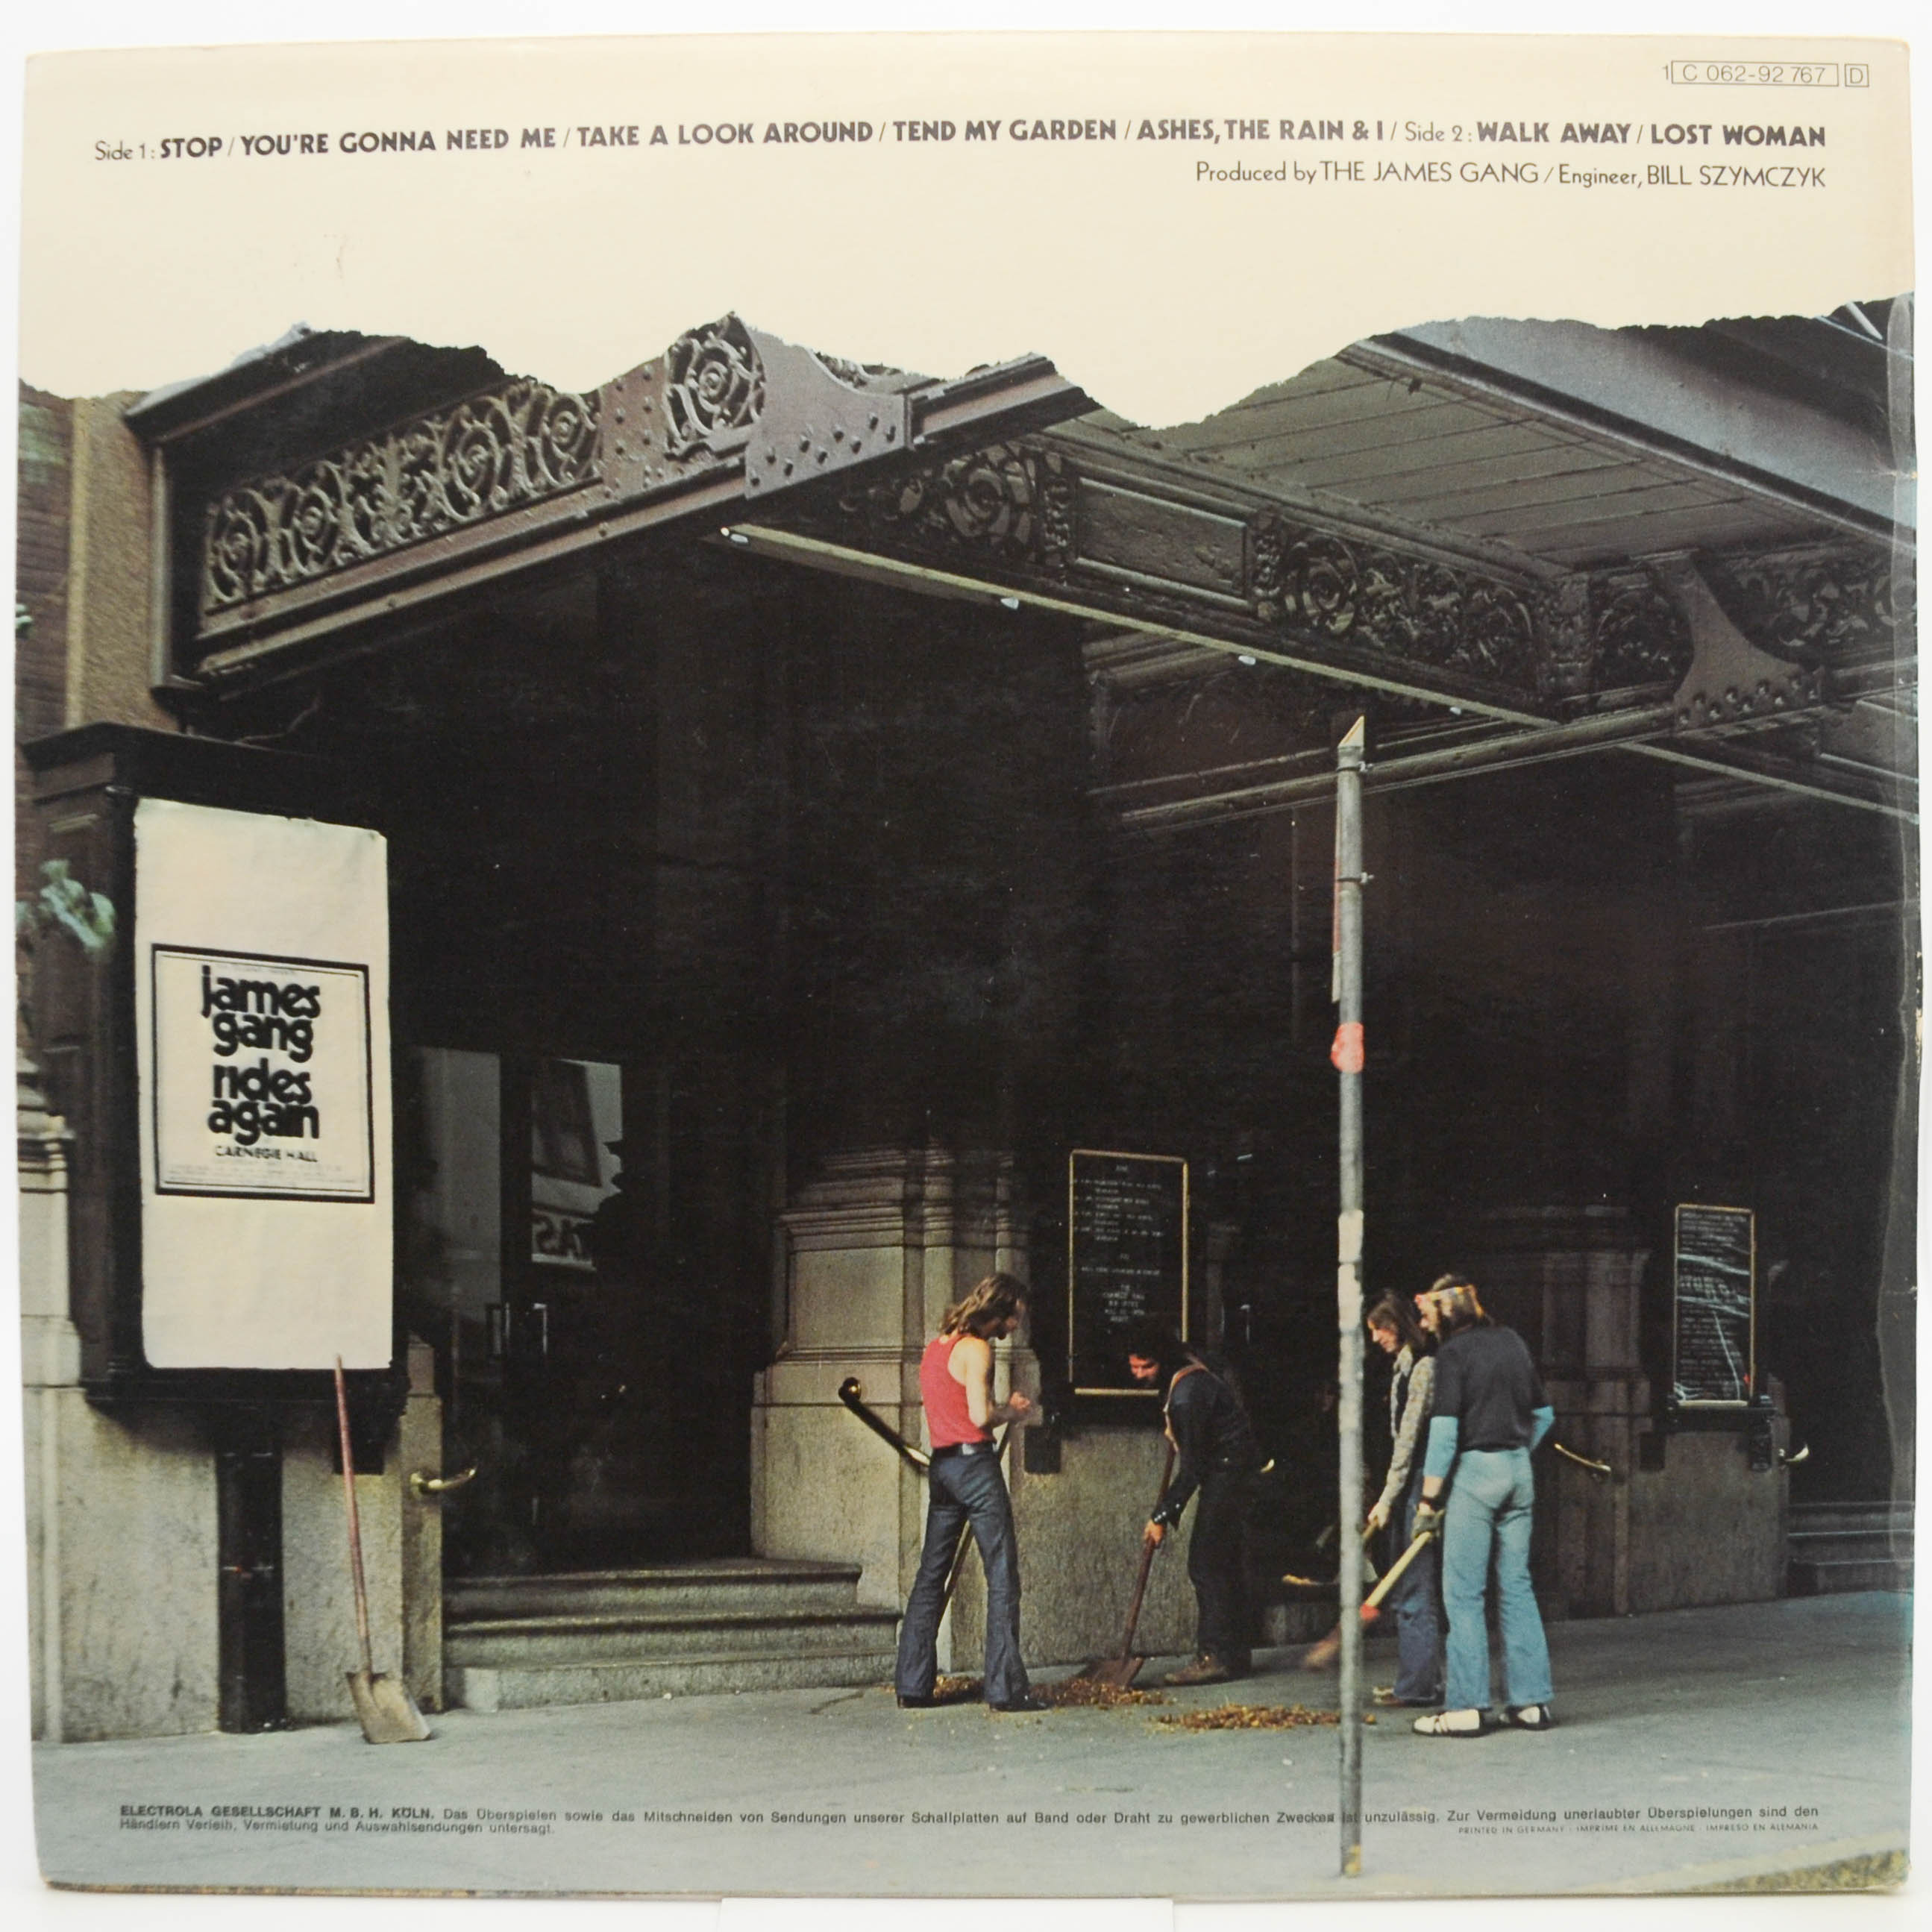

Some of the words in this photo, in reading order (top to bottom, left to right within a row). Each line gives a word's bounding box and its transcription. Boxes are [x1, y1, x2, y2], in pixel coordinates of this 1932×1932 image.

[1682, 64, 1699, 82] C
[1789, 66, 1825, 84] 767
[1849, 67, 1864, 84] D
[95, 139, 134, 161] Side
[160, 136, 223, 160] STOP
[239, 133, 329, 157] YOU'RE
[339, 131, 437, 154] GONNA
[446, 128, 509, 151] NEED
[519, 127, 556, 148] ME
[576, 125, 640, 147] TAKE
[648, 125, 669, 146] A
[678, 122, 755, 145] LOOK
[762, 120, 874, 144] AROUND
[892, 119, 957, 142] TEND
[964, 119, 1003, 142] MY
[1009, 119, 1117, 141] GARDEN
[1136, 119, 1221, 145] ASHES,
[1224, 119, 1270, 140] THE
[1279, 119, 1344, 141] RAIN
[1352, 119, 1370, 141] &
[1405, 120, 1445, 142] Side
[1475, 120, 1550, 143] WALK
[1559, 122, 1632, 145] AWAY
[1650, 123, 1713, 145] LOST
[1722, 124, 1826, 148] WOMAN
[1196, 160, 1287, 182] Produced
[1293, 162, 1317, 185] by
[1319, 161, 1366, 182] THE
[1373, 160, 1452, 183] JAMES
[1459, 161, 1539, 184] GANG
[1558, 163, 1643, 189] Engineer,
[1647, 164, 1693, 186] BILL
[1699, 164, 1826, 188] SZYMCZYK
[201, 965, 321, 1019] james
[213, 1012, 314, 1064] gang
[207, 1100, 320, 1147] again
[216, 1144, 282, 1161] CARNEGIE
[119, 1804, 203, 1819] ELECTROLA
[210, 1804, 322, 1819] GESELLSCHAFT
[391, 1805, 435, 1820] KÖLN.
[442, 1807, 468, 1821] Das
[476, 1807, 557, 1824] Überspielen
[564, 1809, 603, 1822] sowie
[611, 1808, 636, 1822] das
[644, 1810, 733, 1824] Mitschneiden
[739, 1813, 765, 1824] von
[771, 1810, 847, 1826] Sendungen
[853, 1813, 906, 1825] unserer
[911, 1810, 1000, 1826] Schallplatten
[1006, 1811, 1027, 1825] auf
[1034, 1811, 1069, 1825] Band
[1076, 1811, 1108, 1825] oder
[1114, 1811, 1150, 1825] Draht
[1157, 1813, 1173, 1825] zu
[1180, 1811, 1270, 1827] gewerblichen
[1364, 1810, 1440, 1827] unzulässig.
[1446, 1809, 1471, 1822] Zur
[1476, 1808, 1557, 1823] Vermeidung
[1564, 1807, 1641, 1821] unerlaubter
[1647, 1806, 1753, 1823] Überspielungen
[1758, 1805, 1787, 1819] sind
[1793, 1805, 1819, 1819] den
[119, 1819, 181, 1831] Händlern
[243, 1820, 319, 1835] Vermietung
[324, 1821, 350, 1833] und
[354, 1820, 483, 1836] Auswahlsendungen
[488, 1822, 556, 1837] untersagt.
[1458, 1825, 1498, 1835] PRINTED
[1502, 1825, 1514, 1835] IN
[1517, 1825, 1566, 1835] GERMANY
[1622, 1823, 1637, 1834] EN
[1640, 1823, 1696, 1834] ALLEMAGNE
[1706, 1822, 1750, 1833] IMPRESO
[1752, 1822, 1766, 1833] EN
[1769, 1822, 1819, 1833] ALEMANIA
